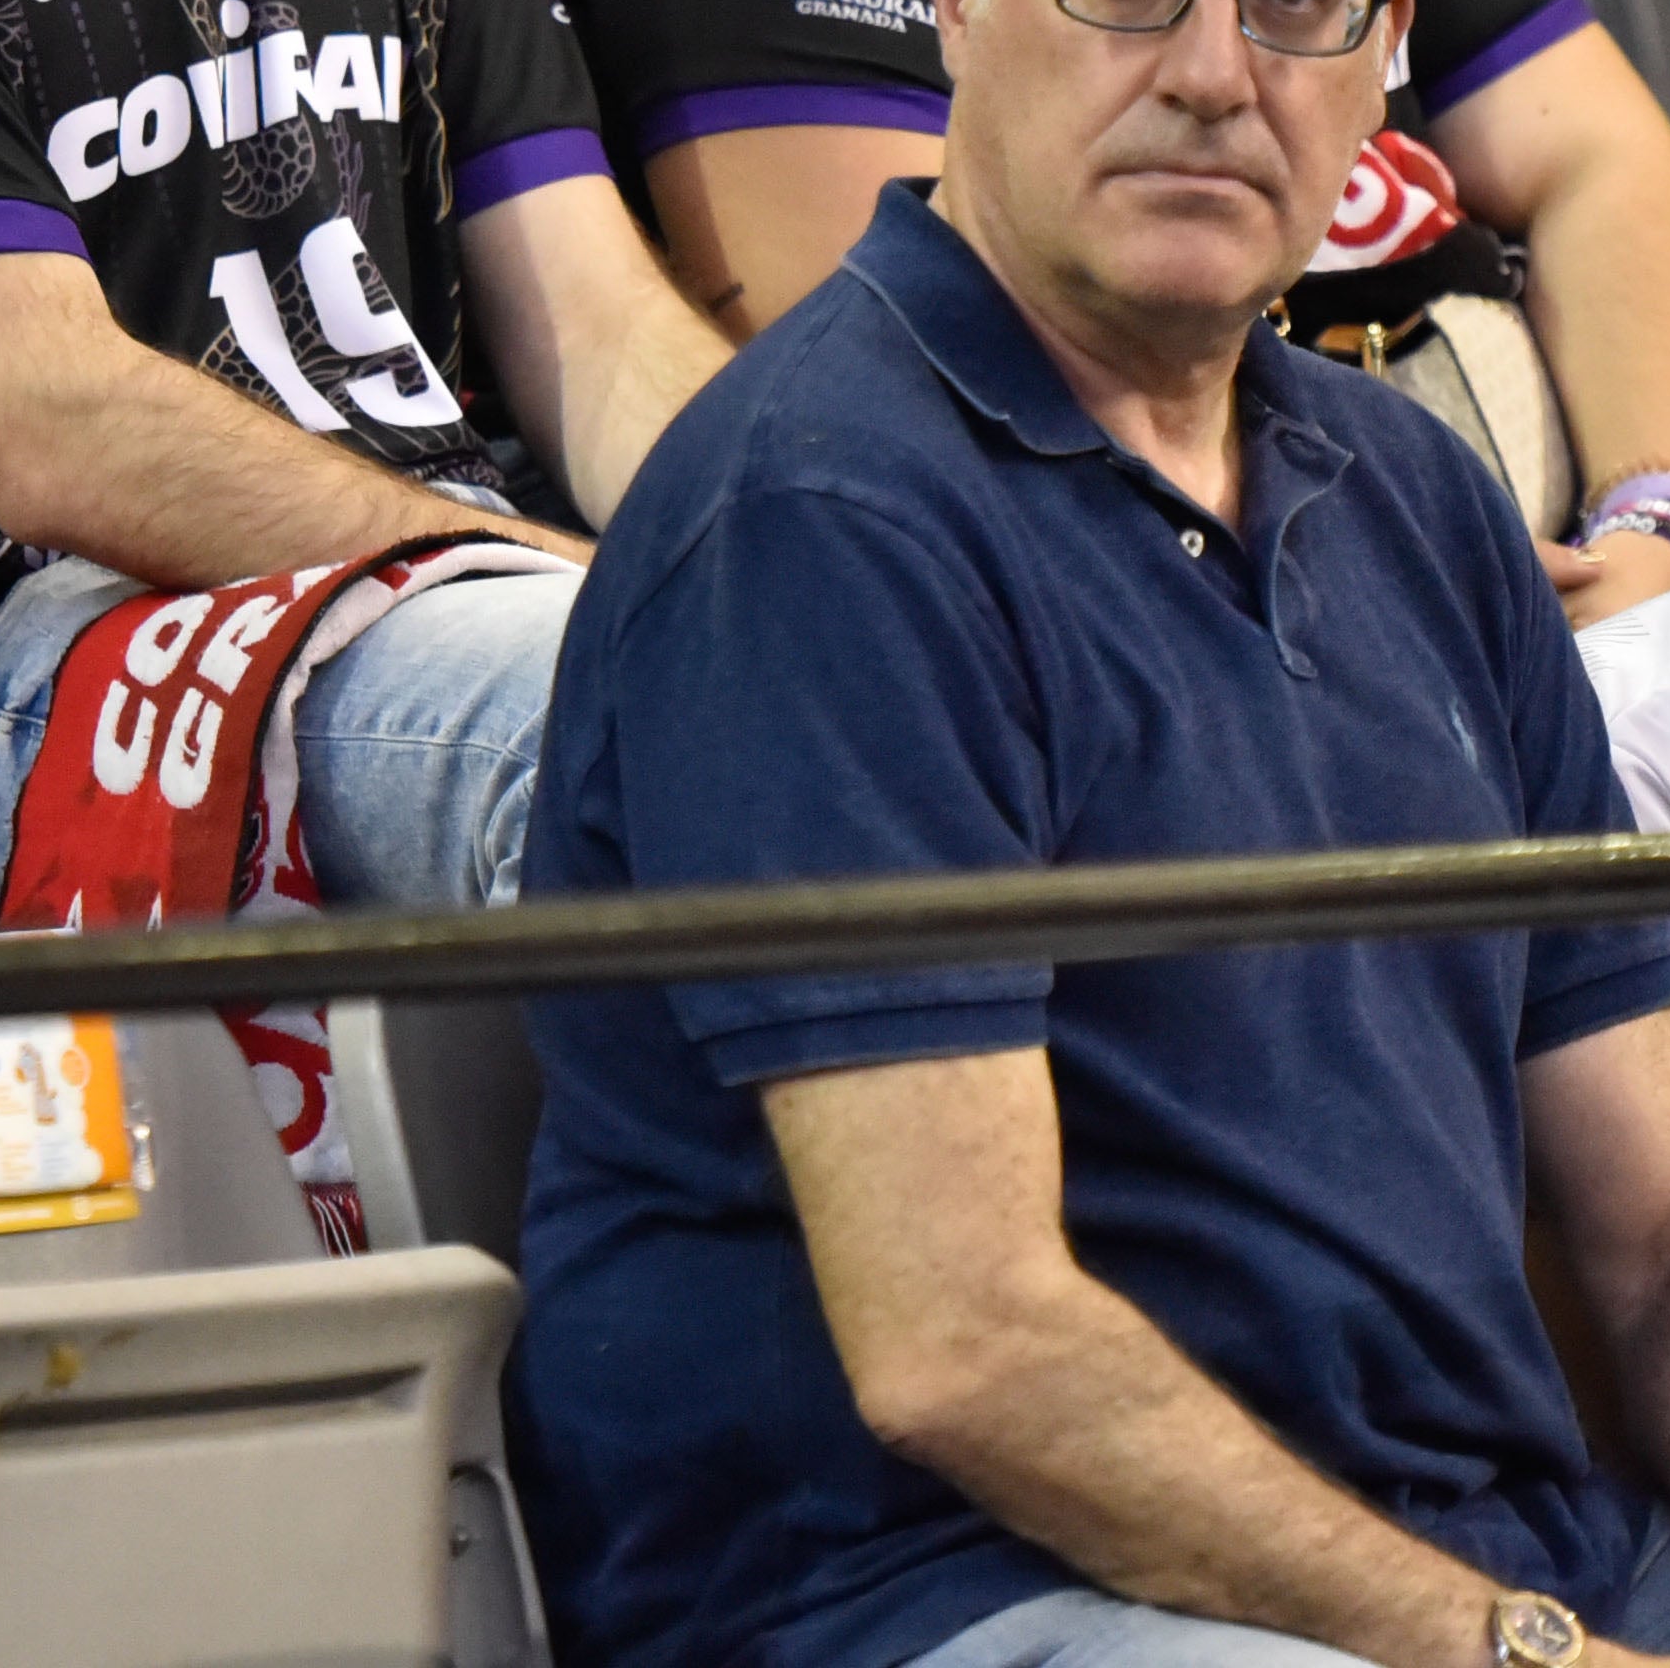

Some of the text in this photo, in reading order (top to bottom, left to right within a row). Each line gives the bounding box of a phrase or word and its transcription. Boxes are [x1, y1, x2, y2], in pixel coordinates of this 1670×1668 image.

[795, 0, 908, 33] GRANADA
[209, 216, 463, 433] 19
[92, 582, 231, 795] CO
